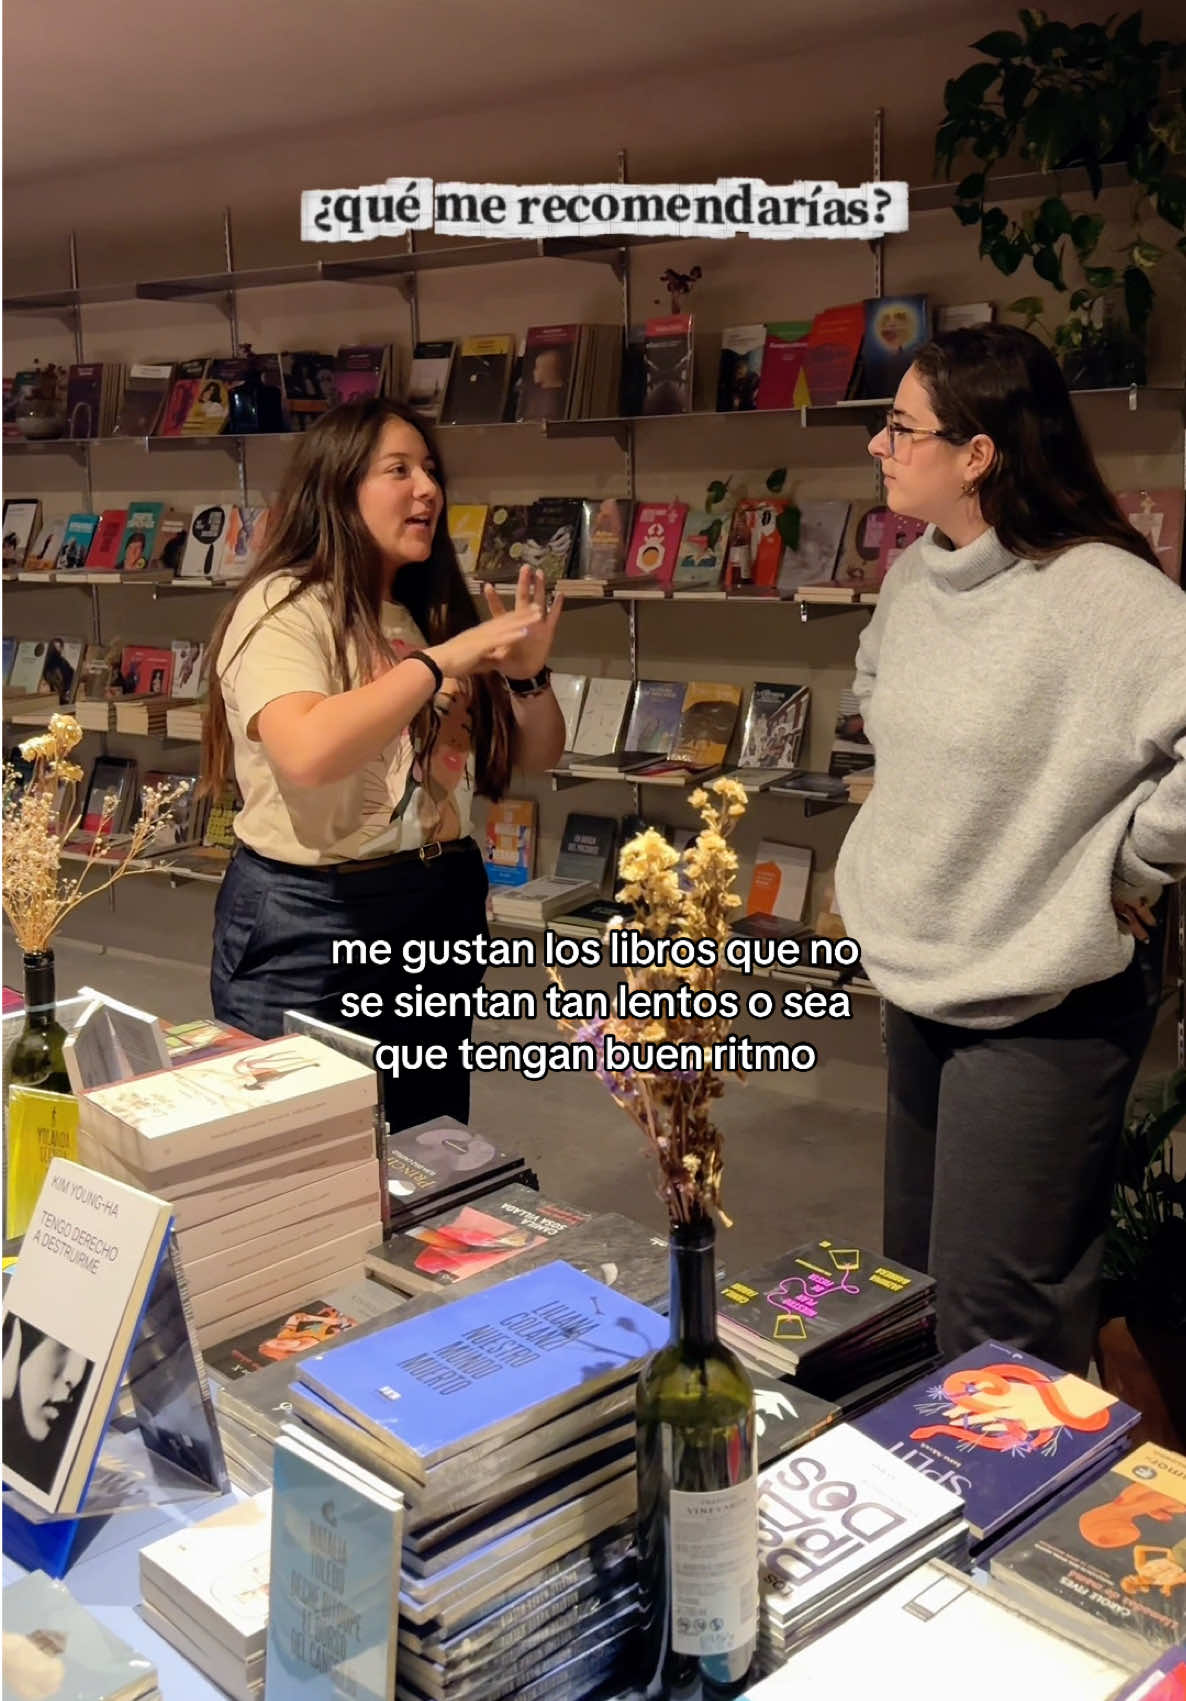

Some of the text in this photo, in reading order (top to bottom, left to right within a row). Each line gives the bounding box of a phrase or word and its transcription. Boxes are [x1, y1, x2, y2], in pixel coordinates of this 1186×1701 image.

[51, 1174, 120, 1218] KIM YOUNG-HA
[32, 1232, 100, 1275] A DESTRUIRME
[40, 1211, 118, 1262] TENGO DERECHO
[432, 1341, 504, 1380] MUNDO
[463, 1324, 541, 1368] NUESTRO
[398, 1353, 473, 1396] MUERTO
